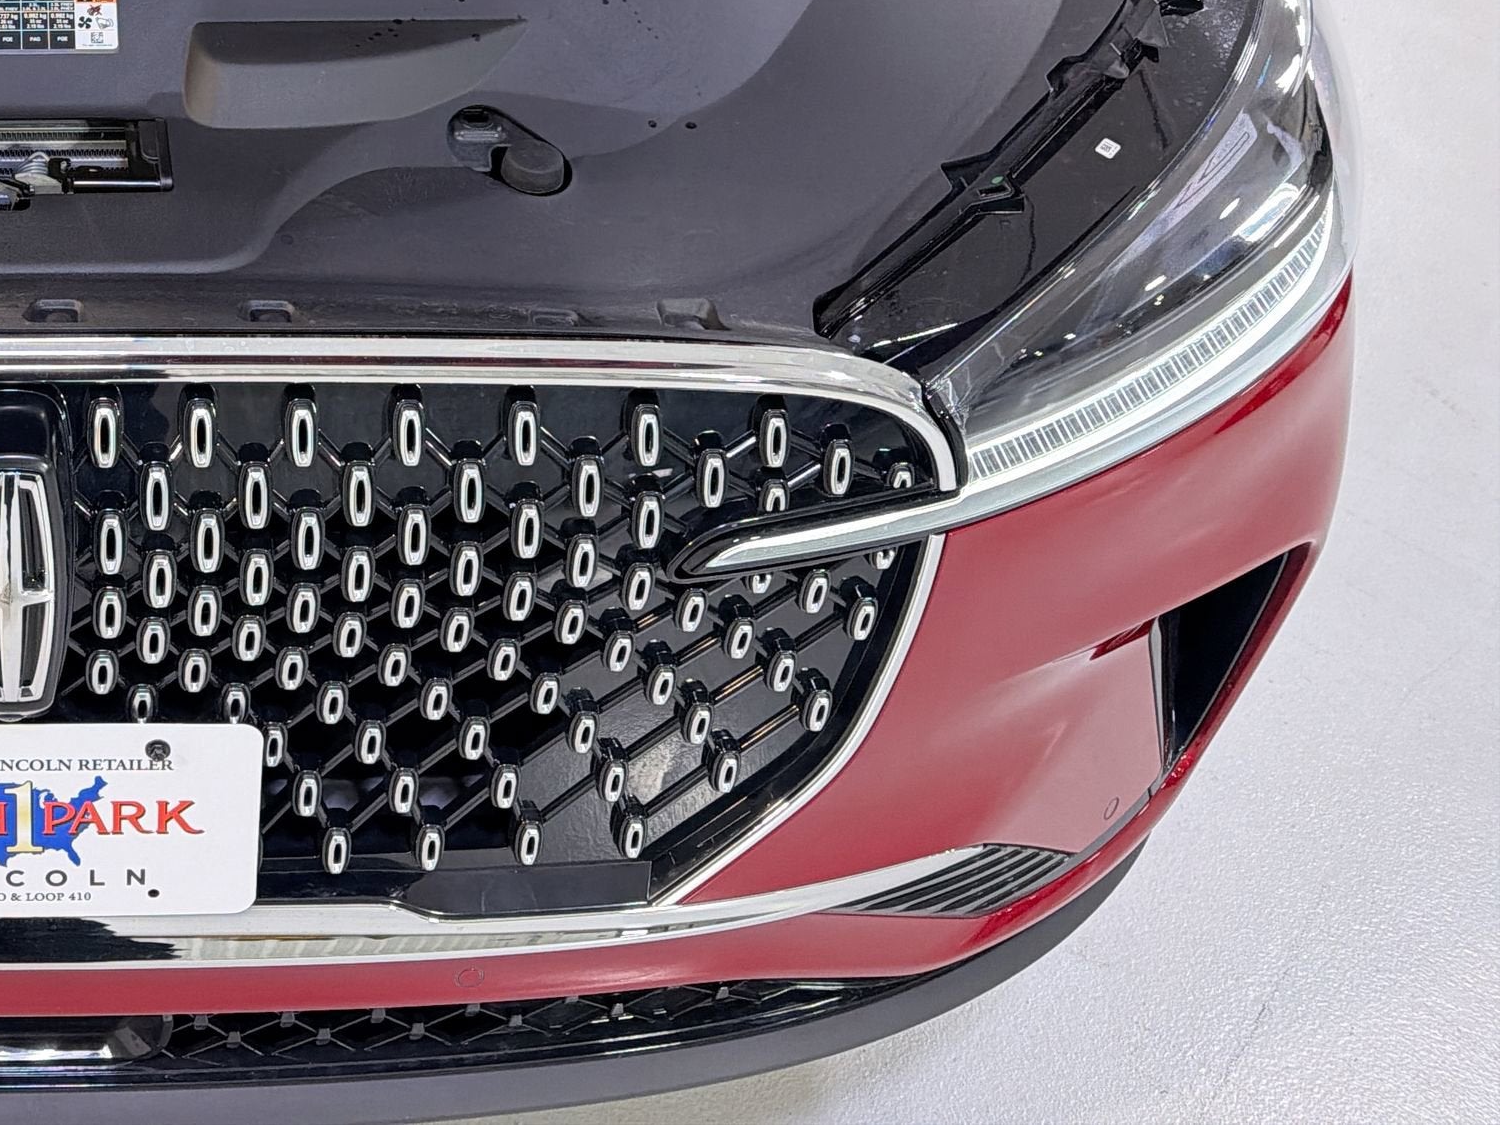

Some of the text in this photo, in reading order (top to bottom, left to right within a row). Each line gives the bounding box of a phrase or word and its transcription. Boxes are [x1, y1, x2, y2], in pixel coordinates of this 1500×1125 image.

[78, 759, 174, 771] RETAILER
[42, 800, 205, 835] PARK
[10, 892, 22, 901] &
[26, 892, 65, 901] LOOP
[68, 892, 92, 901] 410
